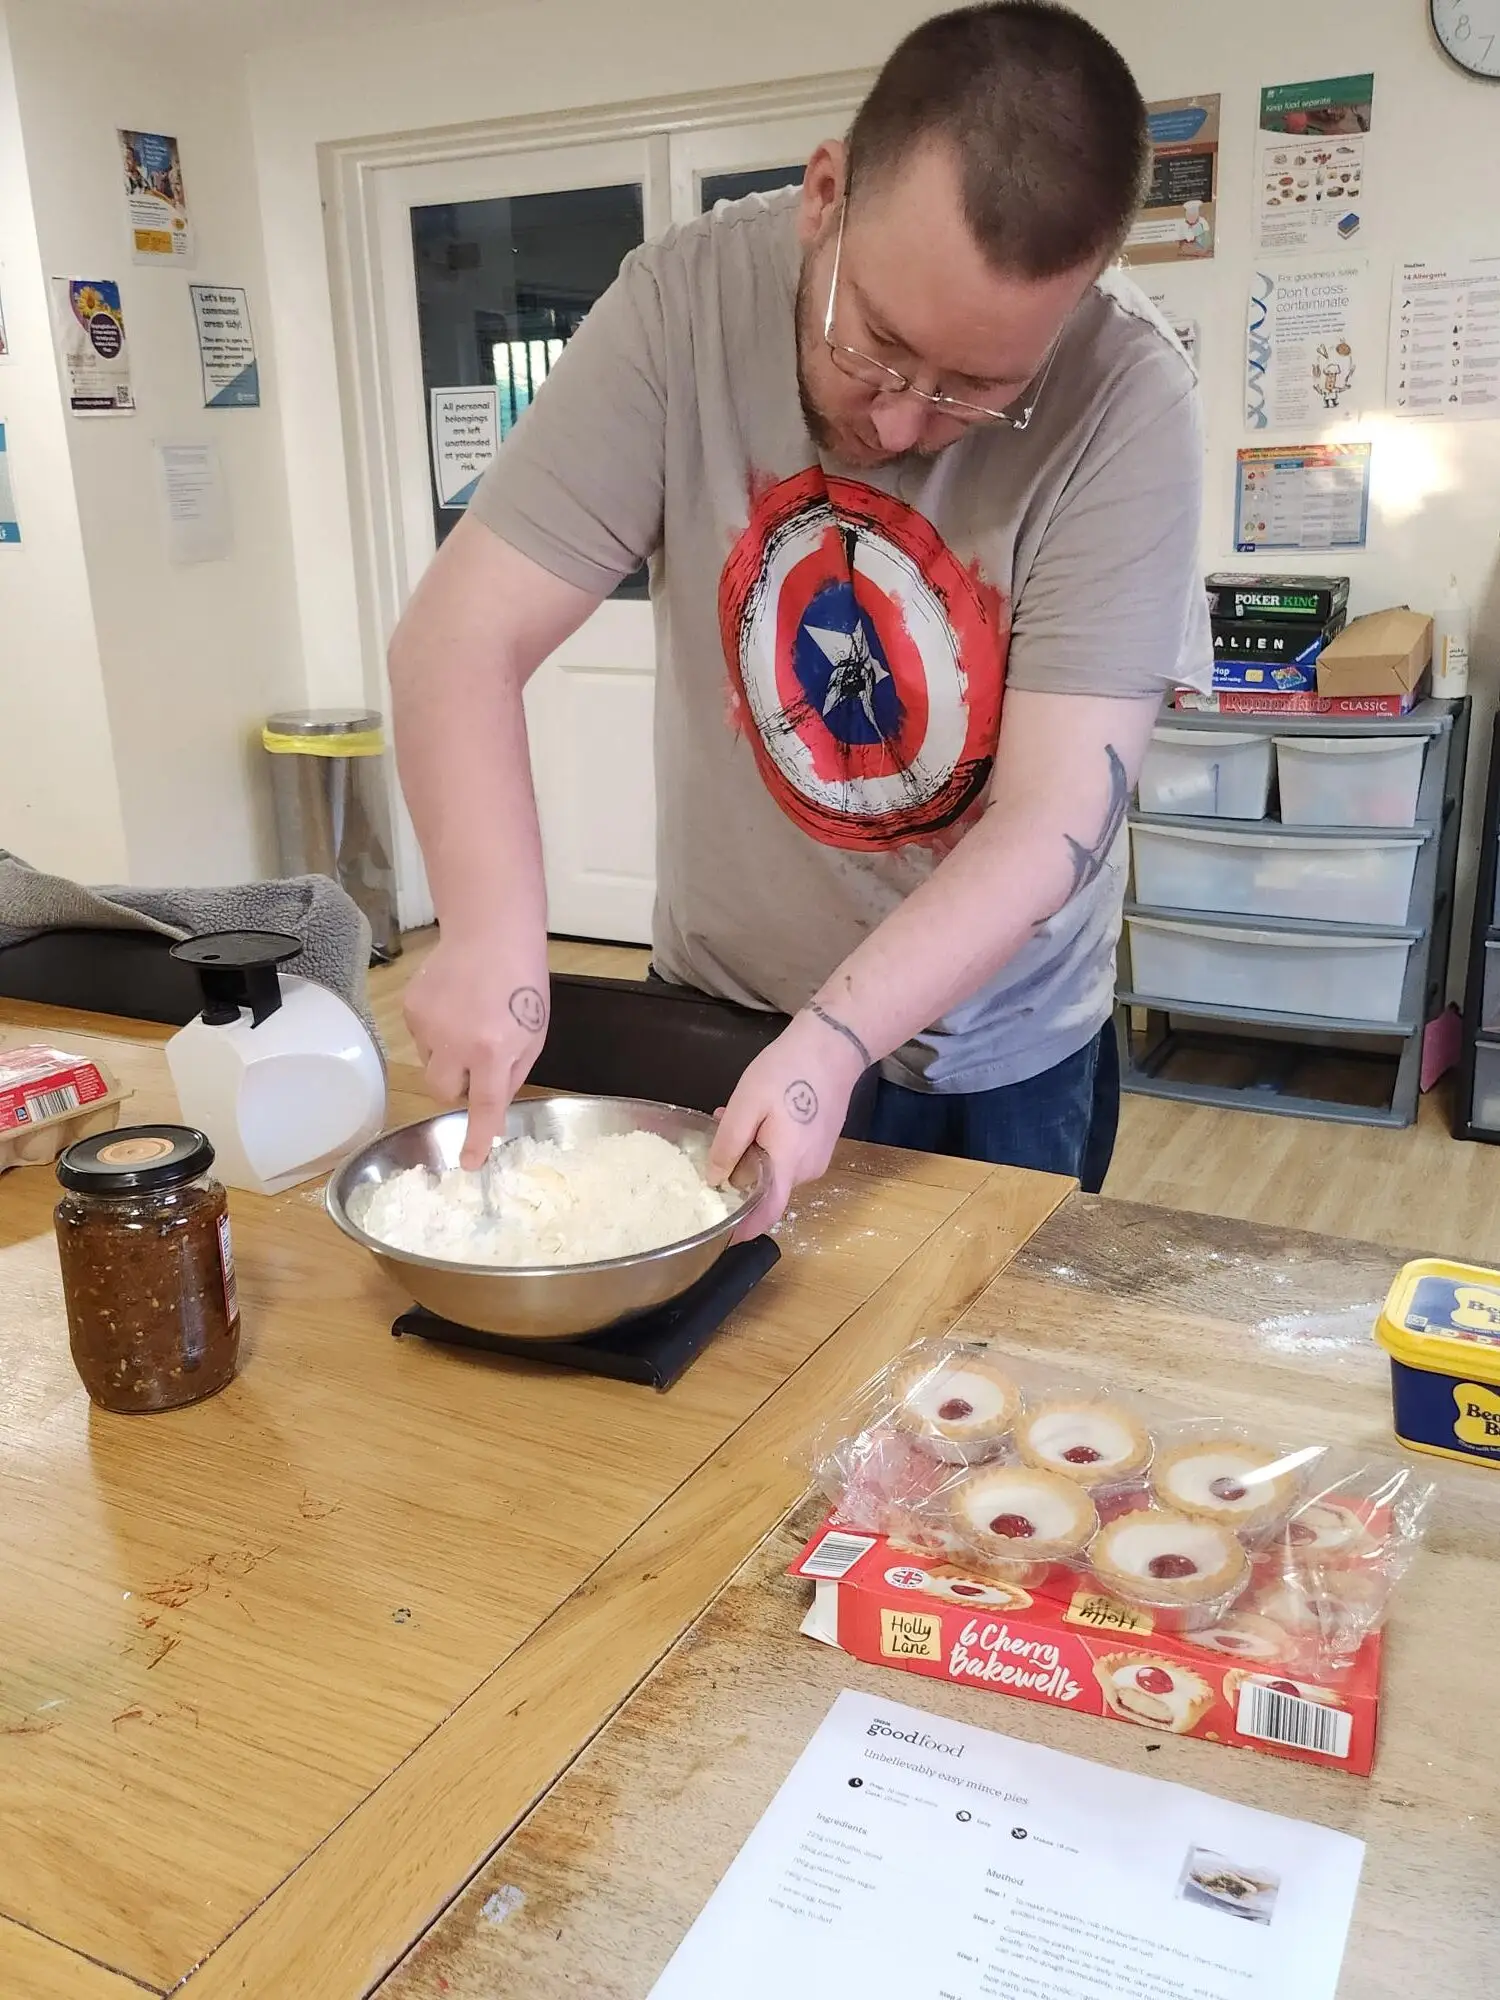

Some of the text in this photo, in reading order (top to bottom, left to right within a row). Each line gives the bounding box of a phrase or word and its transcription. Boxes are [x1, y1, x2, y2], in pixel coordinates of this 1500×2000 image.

[1455, 14, 1471, 41] 8
[1478, 34, 1495, 62] 7
[1265, 98, 1331, 112] Keep food separate
[1294, 271, 1335, 282] goodness
[200, 294, 236, 303] Let's keep
[1276, 285, 1348, 300] Don't cross-
[1276, 297, 1349, 313] contaminate
[455, 402, 490, 412] personal
[445, 415, 488, 424] belongings
[468, 427, 480, 435] left
[445, 439, 490, 447] unattended
[455, 452, 472, 460] your
[461, 463, 477, 471] risk.
[1235, 594, 1317, 607] POKER KING
[1214, 636, 1284, 650] ALIEN
[1340, 701, 1387, 711] CLASSIC
[891, 1616, 932, 1642] Holly
[891, 1638, 930, 1656] Lane
[960, 1619, 1059, 1670] 6 Cherry
[948, 1642, 1083, 1701] Bakewells
[864, 1748, 1029, 1806] Unbelievably easy mince pies
[816, 1812, 868, 1836] Ingredients
[986, 1868, 1024, 1887] Method
